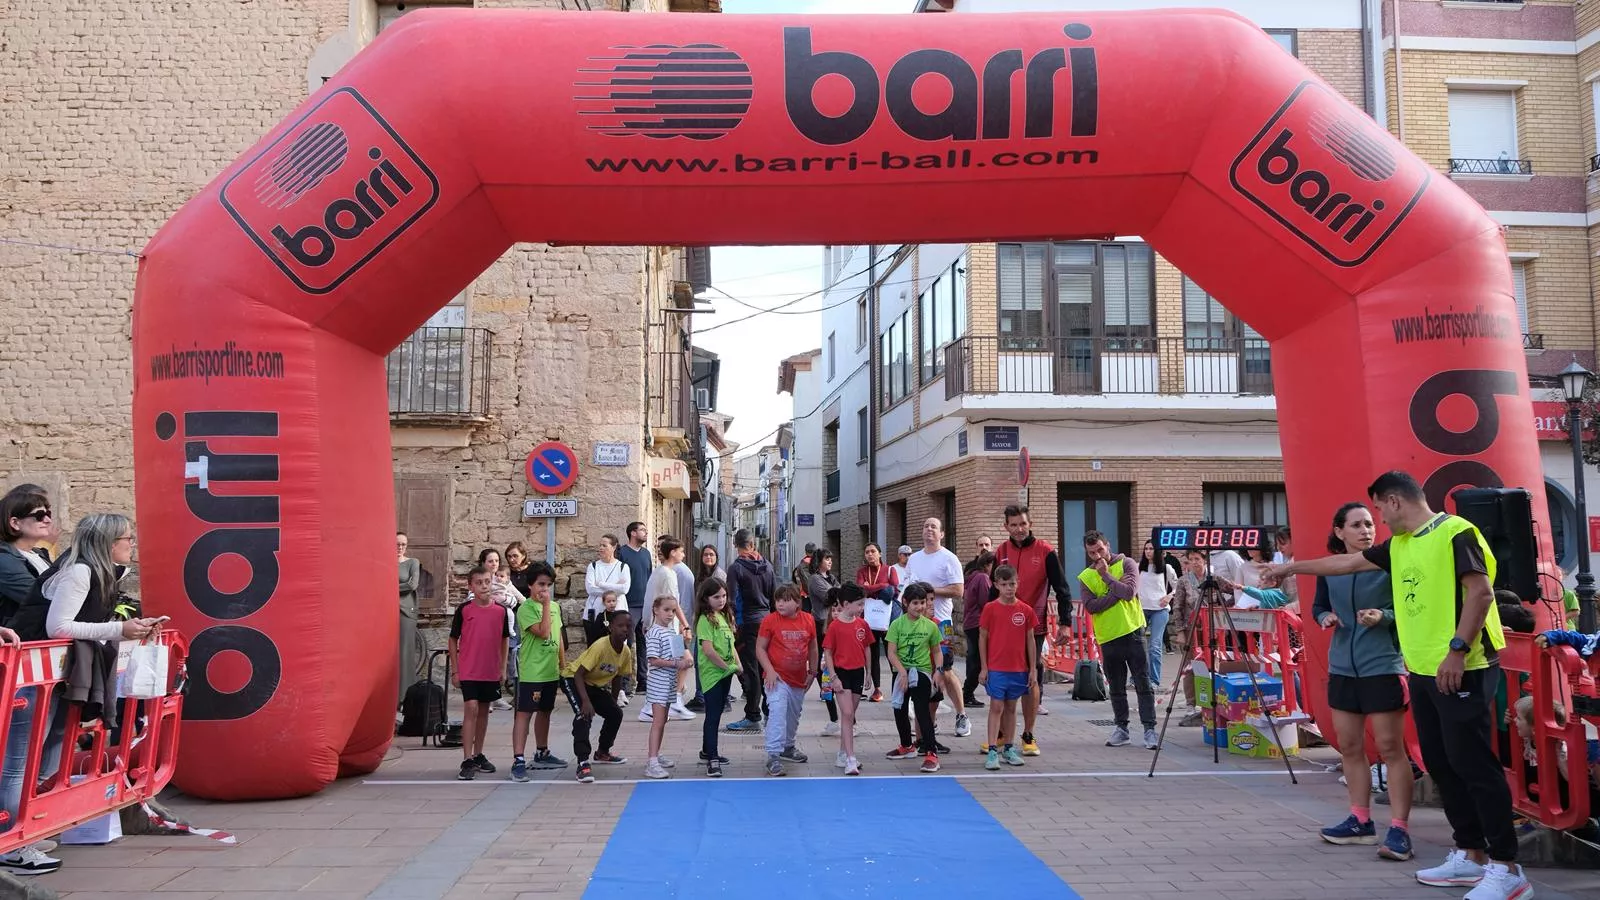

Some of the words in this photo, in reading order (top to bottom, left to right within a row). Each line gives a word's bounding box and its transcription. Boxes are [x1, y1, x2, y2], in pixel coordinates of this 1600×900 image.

[784, 23, 1098, 147] barri
[270, 146, 414, 267] barri
[586, 148, 1099, 173] www.barri-ball.com
[1257, 127, 1386, 245] barri
[151, 340, 284, 387] www.barrisportline.com
[653, 461, 681, 487] BAR
[155, 411, 282, 721] barri
